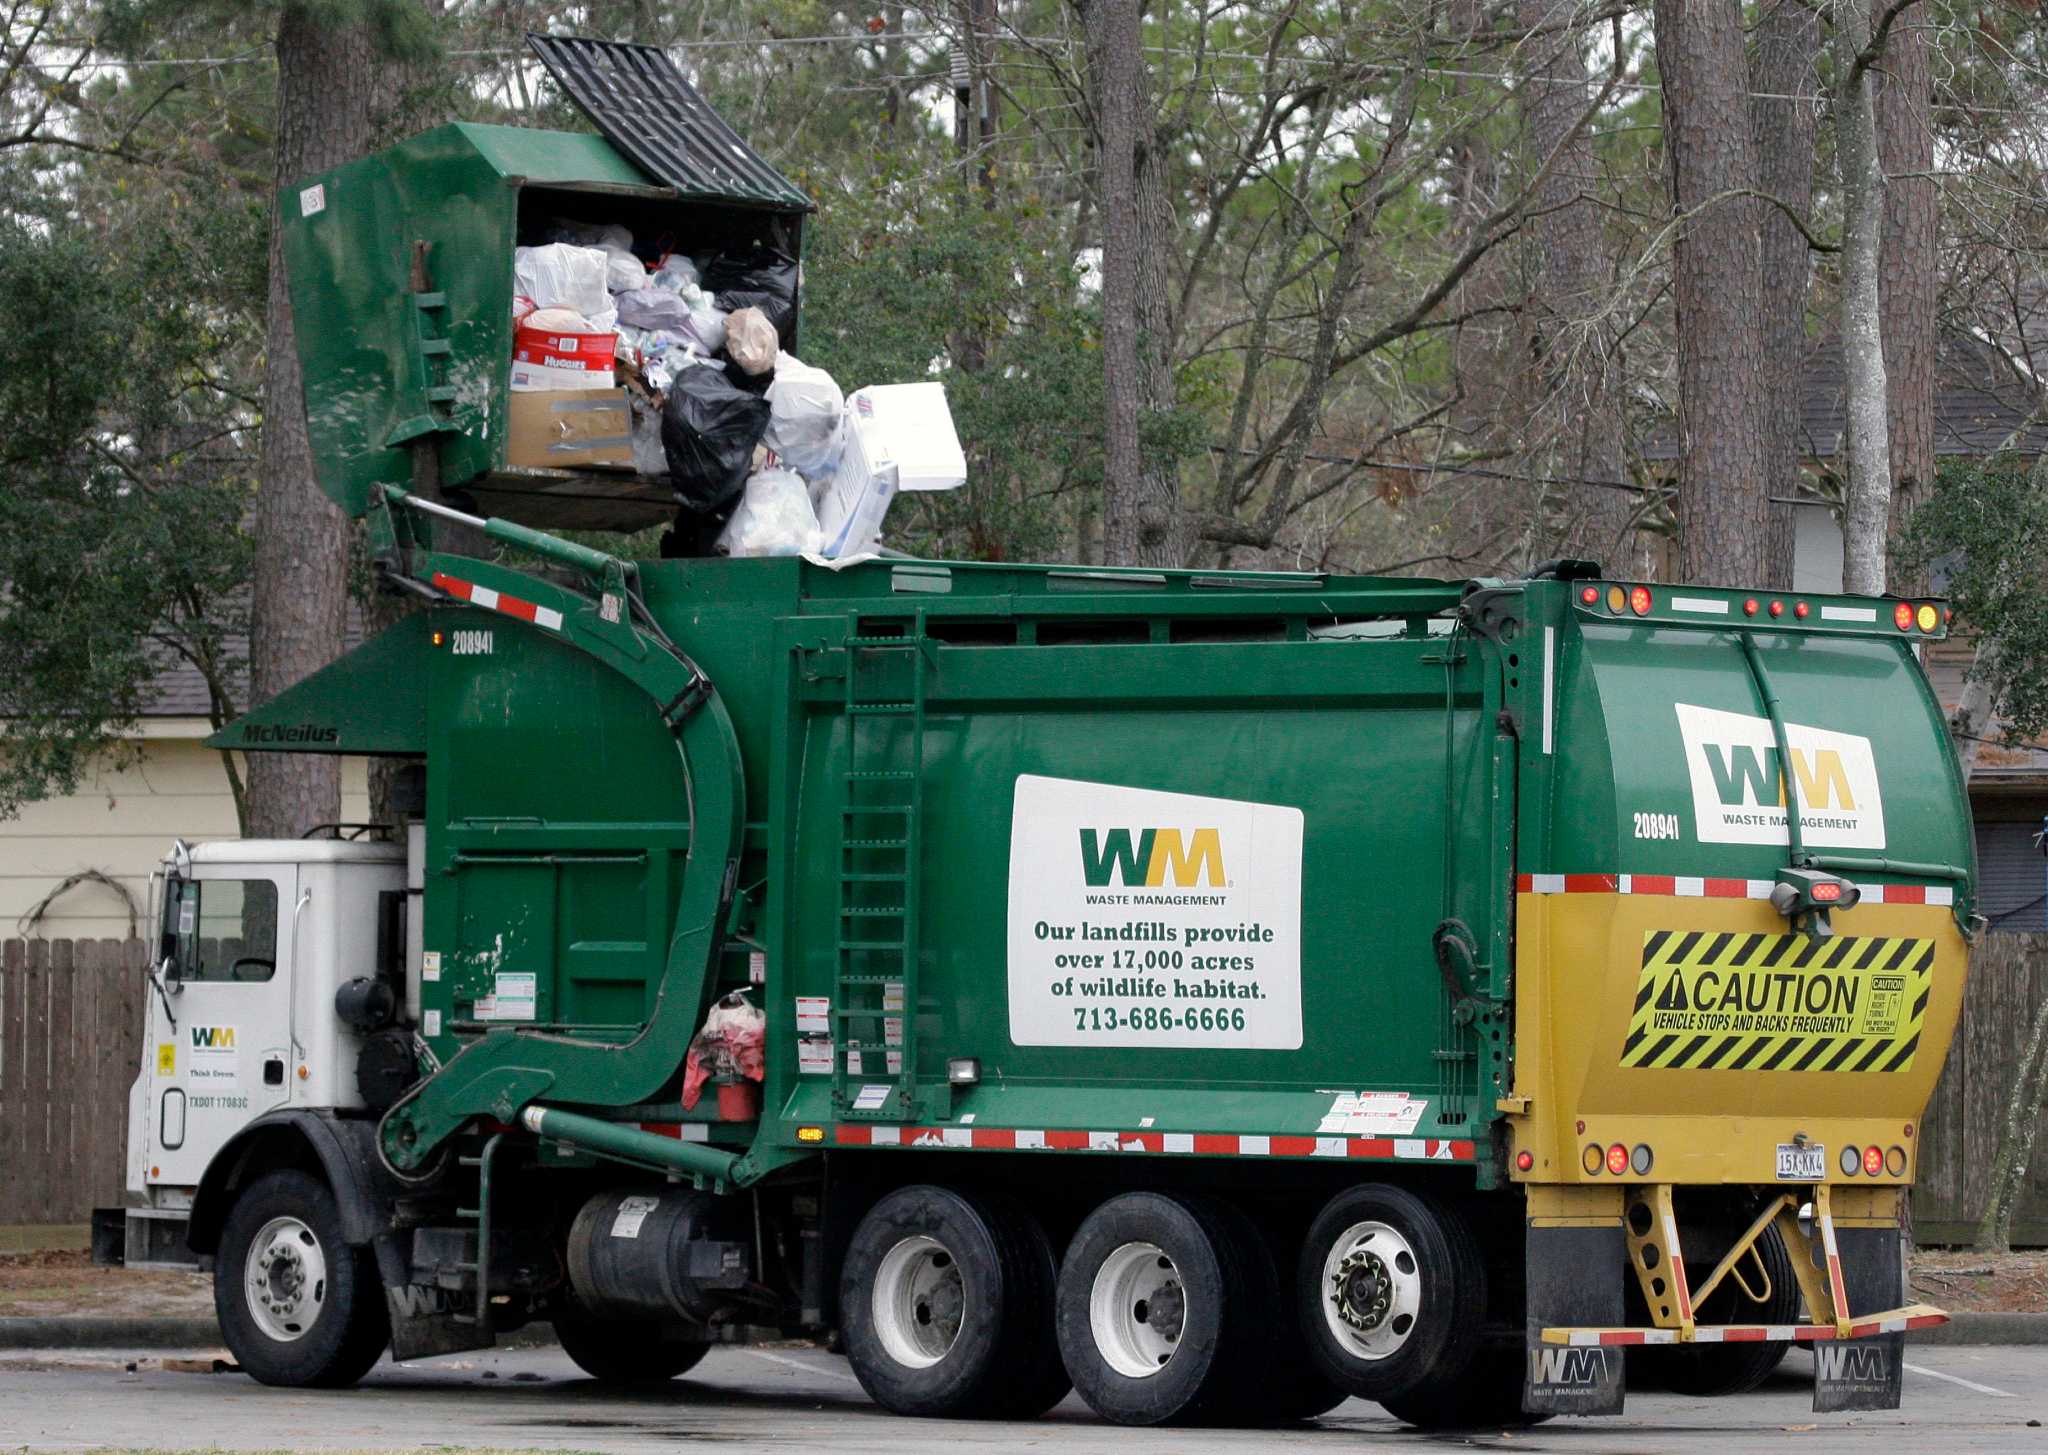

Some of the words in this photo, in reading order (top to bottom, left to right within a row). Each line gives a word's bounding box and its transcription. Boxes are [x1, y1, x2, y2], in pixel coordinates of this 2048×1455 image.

[452, 631, 493, 655] 208941
[242, 724, 337, 743] McNeilus
[1633, 812, 1679, 840] 208941
[1723, 814, 1766, 826] WASTE
[1770, 815, 1858, 829] MAAGEMENT
[1079, 828, 1226, 887] WM
[1086, 895, 1129, 905] WASTE
[1133, 896, 1227, 906] MANAGEMENT
[1034, 921, 1075, 941] Our
[1082, 921, 1177, 942] landfills
[1185, 923, 1274, 947] provide
[1055, 954, 1104, 969] over
[1112, 950, 1183, 973] 17,000
[1191, 955, 1254, 970] acres
[1051, 977, 1074, 996] of
[1080, 978, 1166, 998] wildlife
[1173, 978, 1266, 999] habitat.
[1693, 971, 1860, 1014] CAUTION
[1873, 979, 1904, 990] CAUTION
[1074, 1007, 1246, 1031] 713-686-6666
[1653, 1012, 1695, 1030] VEHICLE
[1697, 1013, 1730, 1031] STOPS
[1732, 1014, 1753, 1031] AND
[1755, 1015, 1789, 1032] BACKS
[1790, 1015, 1854, 1034] FREQUENTLY
[192, 1027, 235, 1047] WM
[189, 1097, 214, 1108] TXDOT
[1532, 1348, 1609, 1384] WM
[1817, 1346, 1886, 1381] WM
